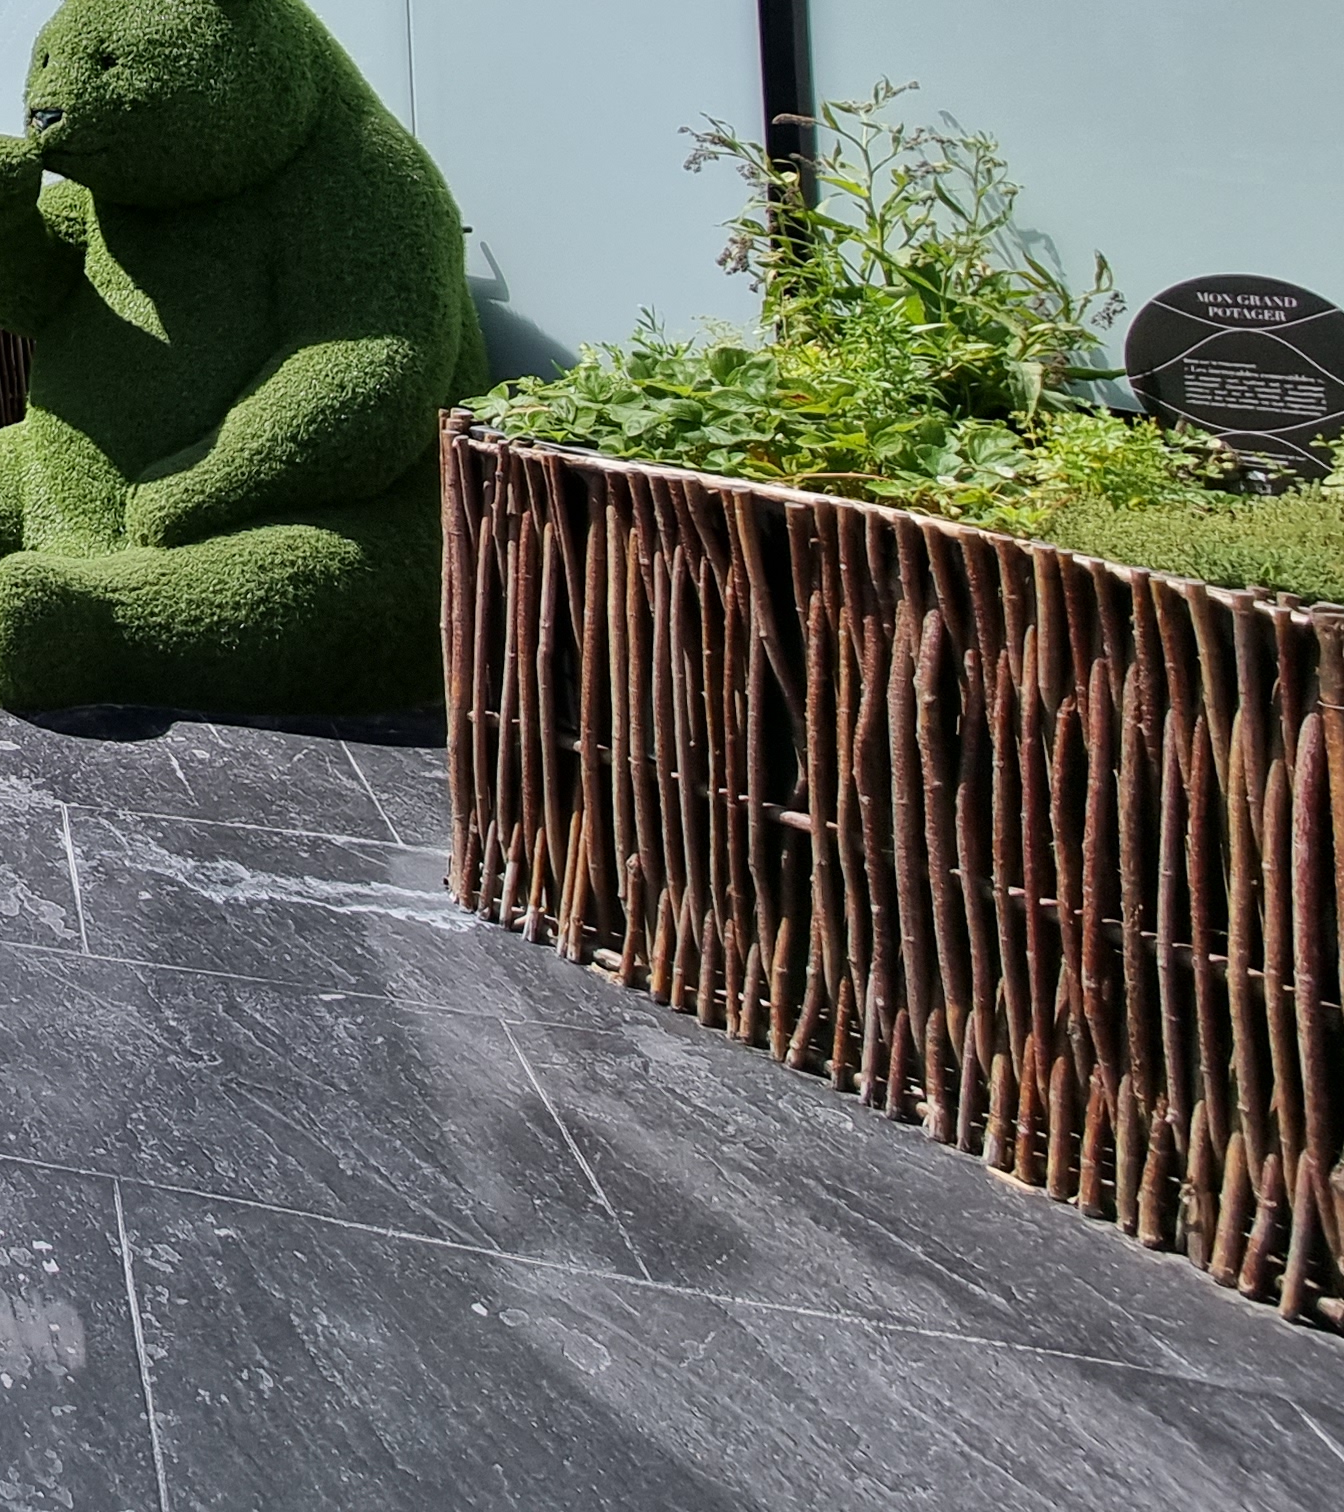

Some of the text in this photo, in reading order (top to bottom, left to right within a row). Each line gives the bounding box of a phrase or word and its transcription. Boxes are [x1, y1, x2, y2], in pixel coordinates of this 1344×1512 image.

[1196, 291, 1298, 308] MON GRAND
[1208, 306, 1287, 322] POTAGER
